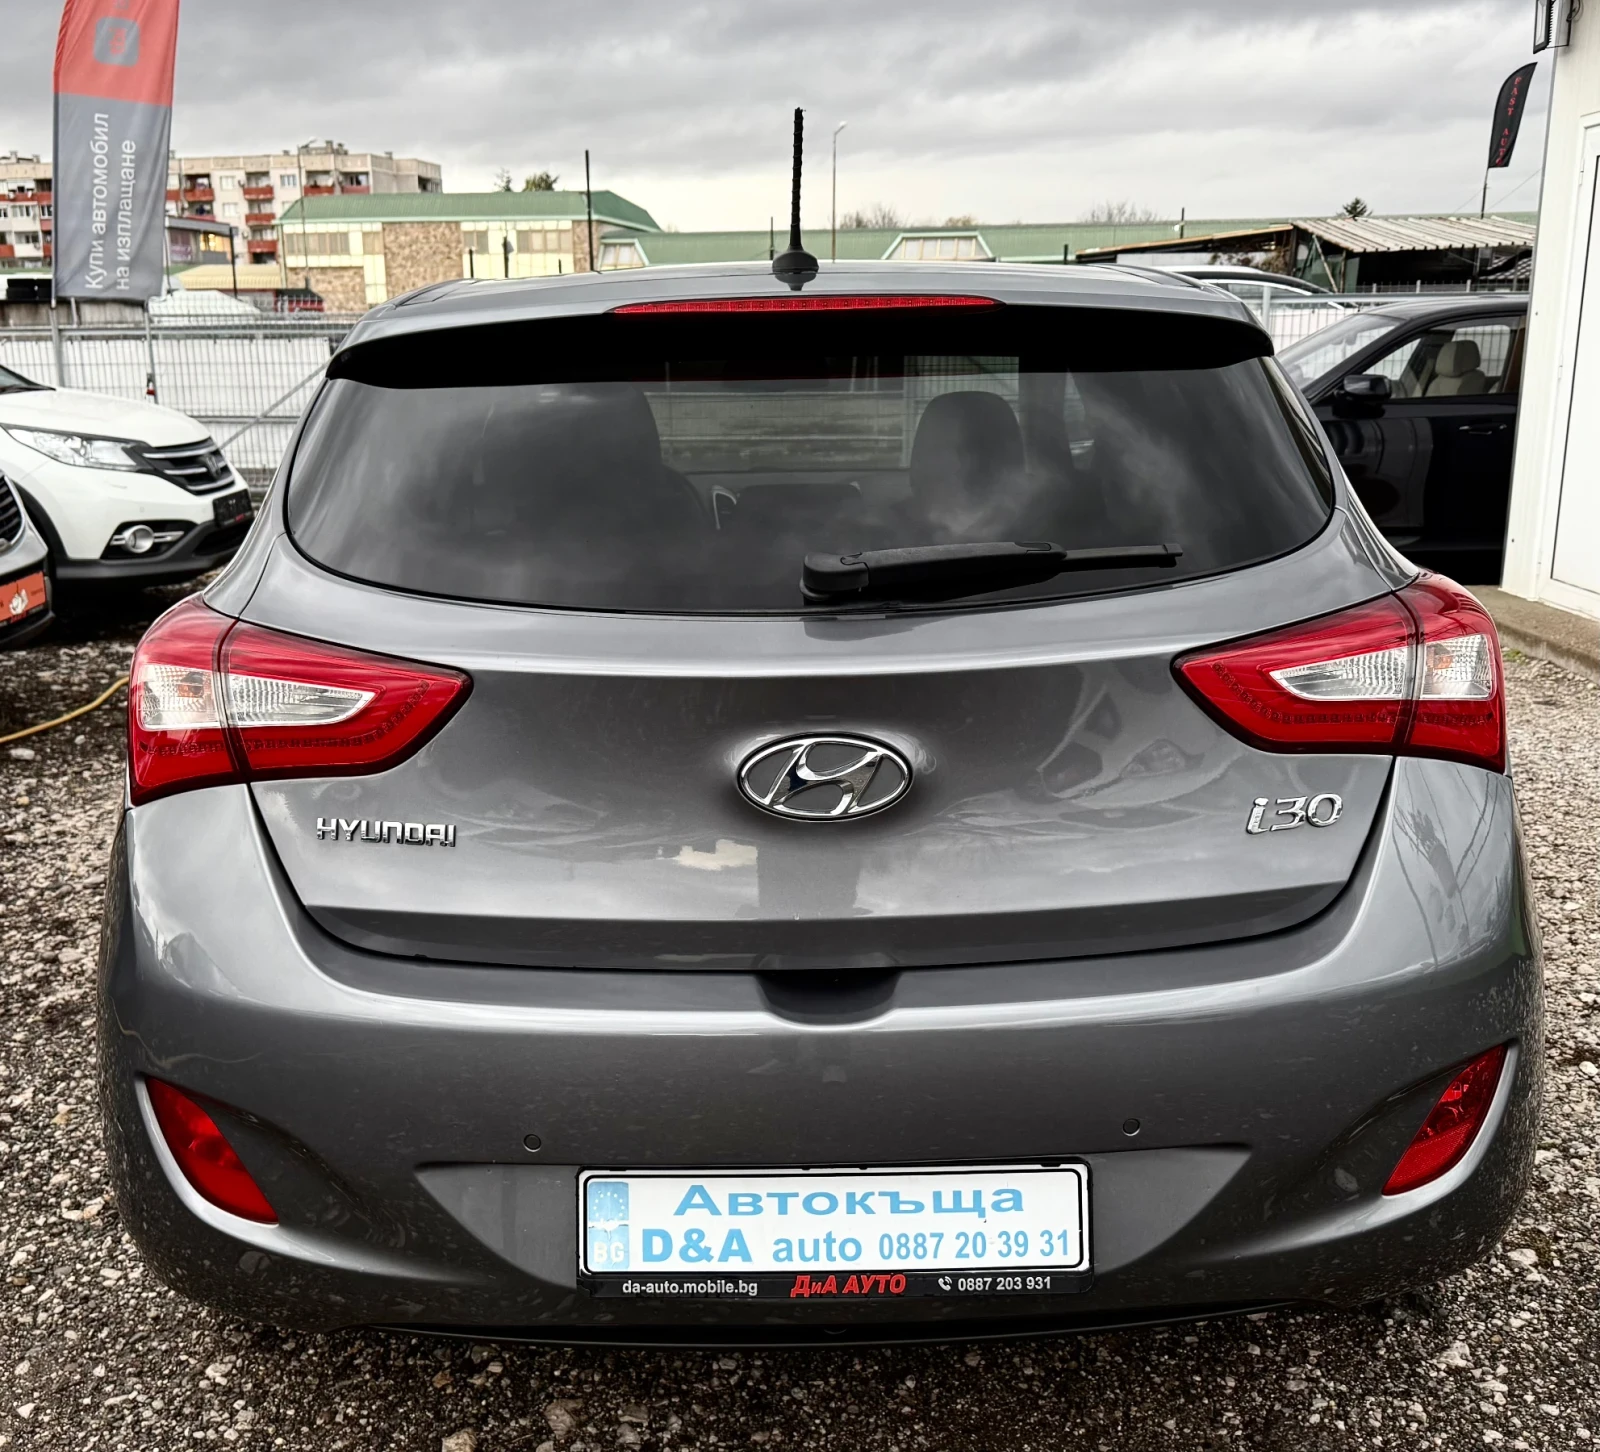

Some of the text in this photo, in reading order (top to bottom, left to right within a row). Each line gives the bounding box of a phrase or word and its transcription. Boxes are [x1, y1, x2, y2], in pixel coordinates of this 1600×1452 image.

[1507, 76, 1522, 116] FAST
[85, 112, 109, 289] Купи автомобил
[117, 139, 136, 290] на изплащане
[1246, 793, 1343, 834] i30
[316, 817, 456, 847] HYUNDAI
[673, 1184, 1024, 1218] Автокъща
[594, 1241, 625, 1263] BG
[642, 1228, 1069, 1263] D&A auto 0887 20 39 31
[622, 1279, 758, 1296] da-auto.mobile.bg
[790, 1273, 906, 1298] ДиА АУТО
[957, 1276, 1051, 1291] 0887 203 931
